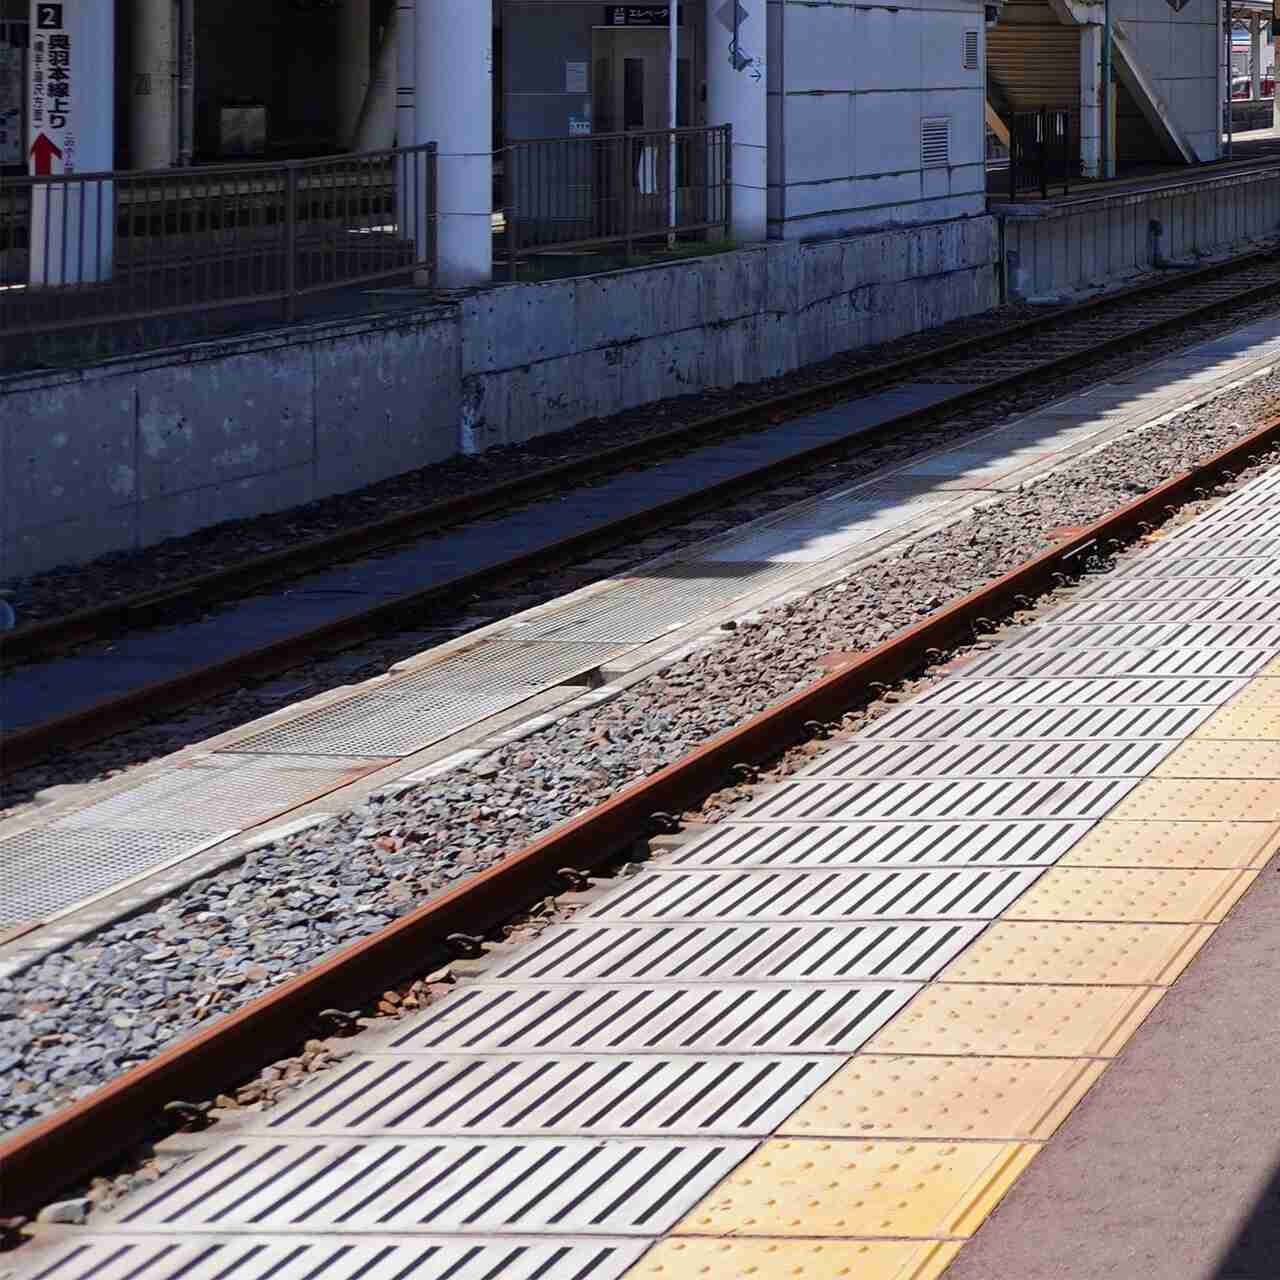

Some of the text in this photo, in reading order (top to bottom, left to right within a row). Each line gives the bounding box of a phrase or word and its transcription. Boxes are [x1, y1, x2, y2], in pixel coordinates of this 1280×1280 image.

[42, 7, 56, 25] 2
[48, 34, 70, 129] 奥羽本線上り
